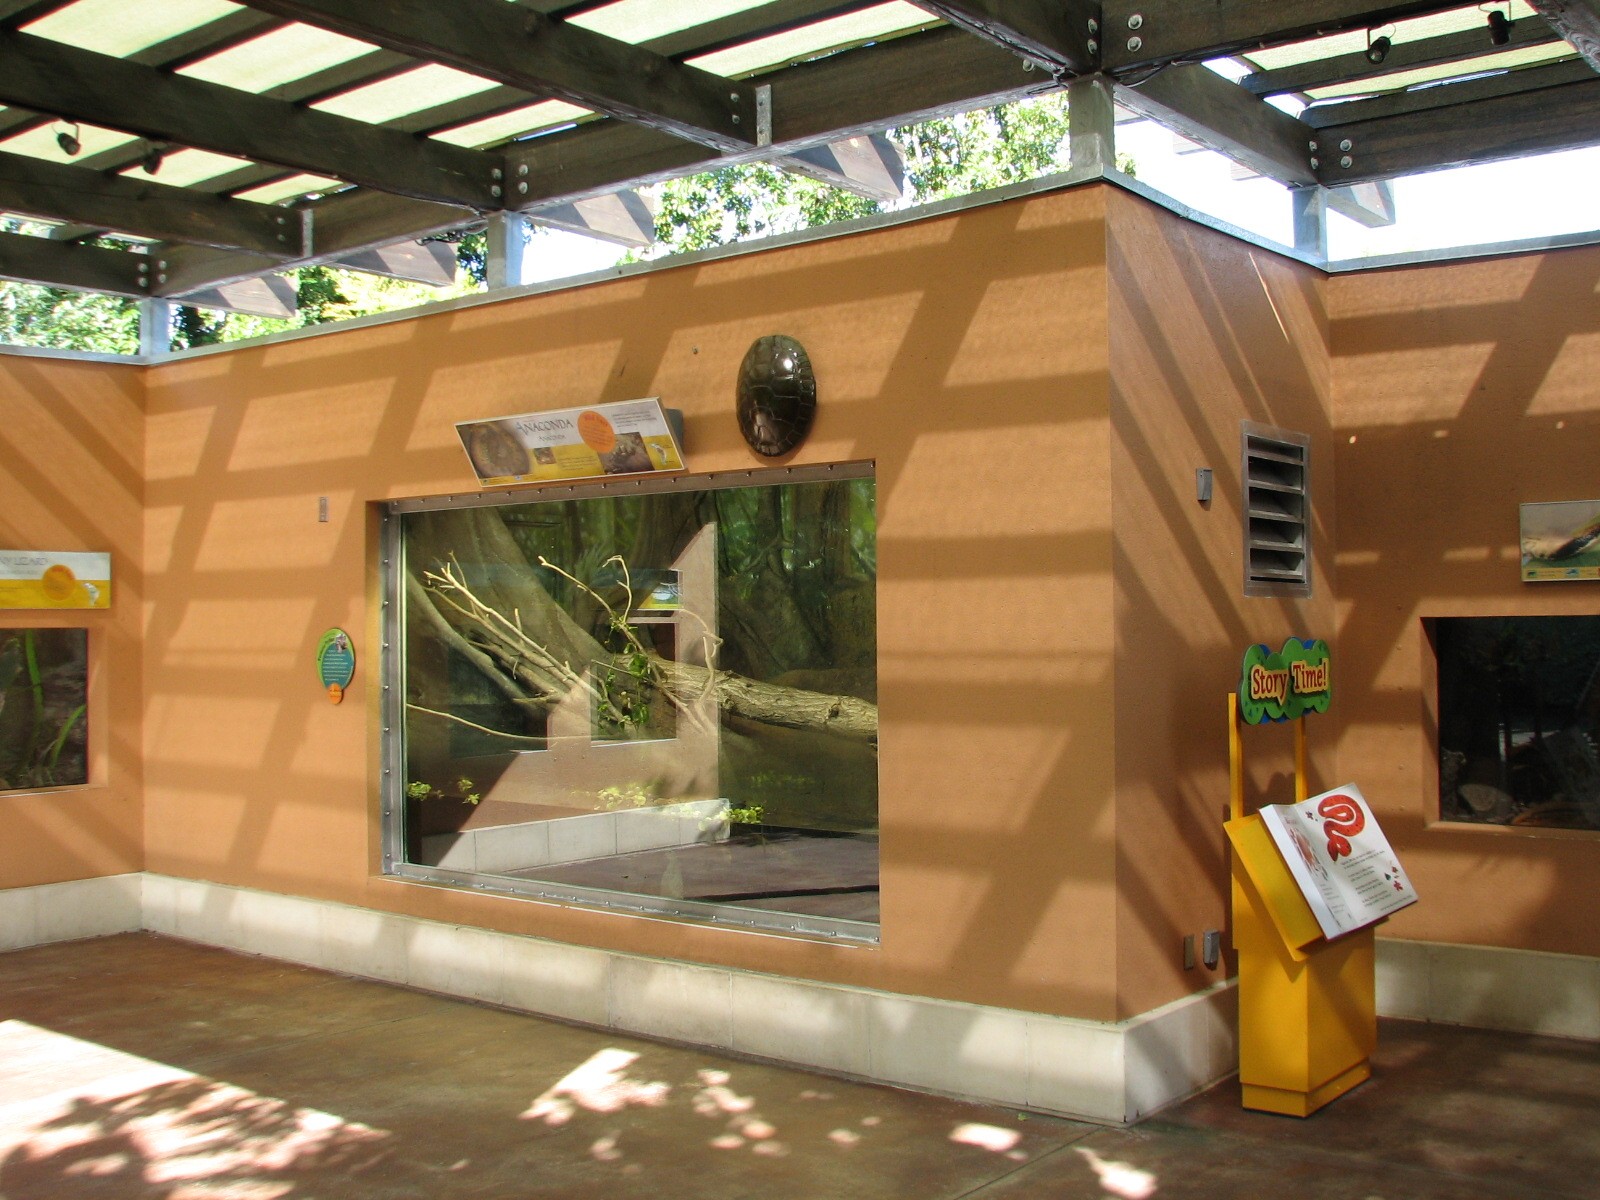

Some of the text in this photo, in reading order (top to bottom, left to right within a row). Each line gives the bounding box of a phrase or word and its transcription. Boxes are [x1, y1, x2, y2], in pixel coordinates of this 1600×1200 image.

[516, 419, 574, 436] ANACONDA
[1253, 661, 1327, 699] Story Time!
